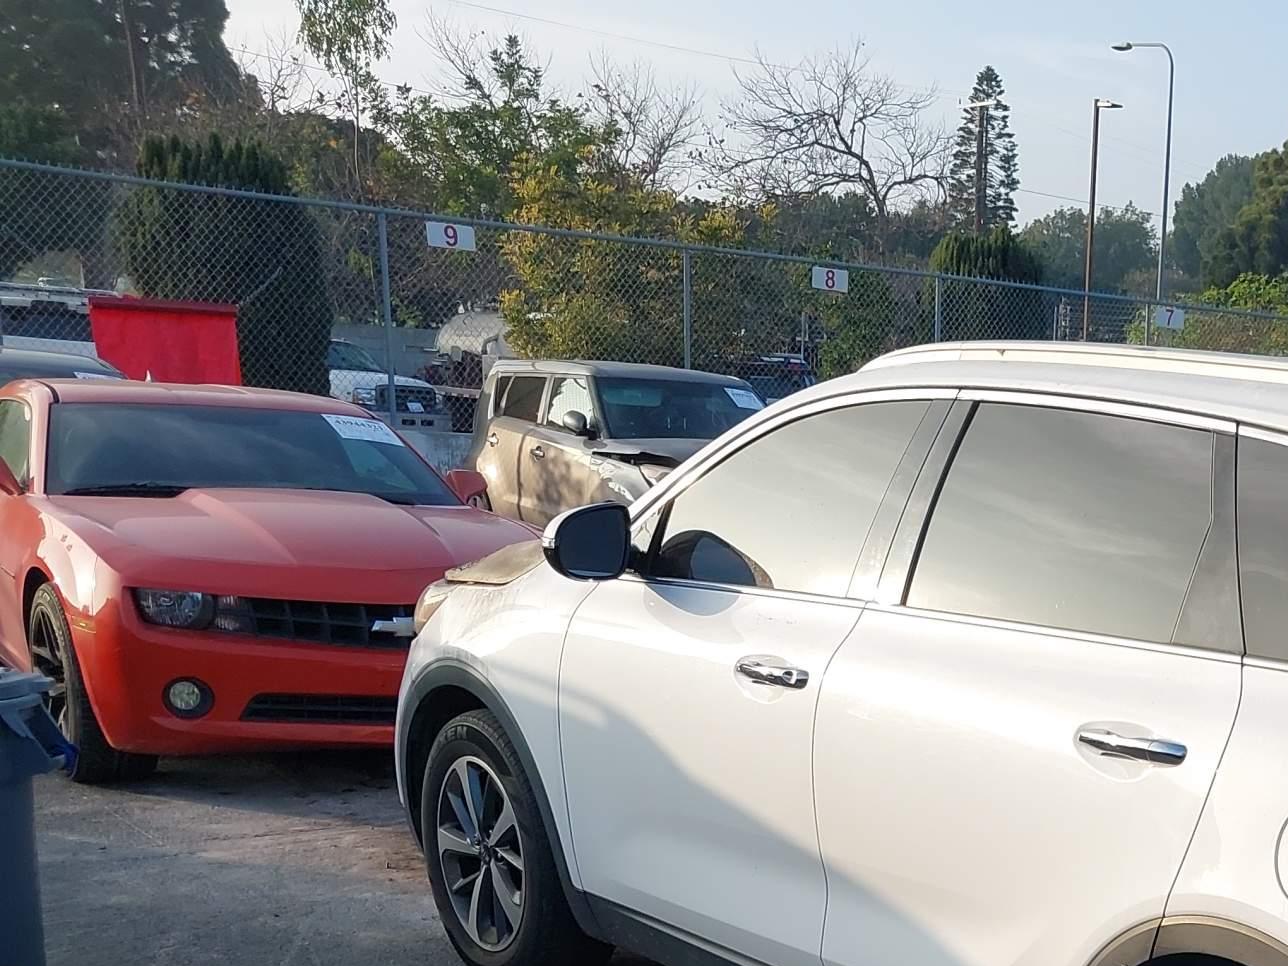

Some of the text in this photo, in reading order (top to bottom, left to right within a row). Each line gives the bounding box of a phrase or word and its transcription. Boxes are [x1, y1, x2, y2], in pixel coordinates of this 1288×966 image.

[444, 225, 458, 247] 9
[825, 270, 835, 289] 8
[1165, 309, 1175, 326] 7
